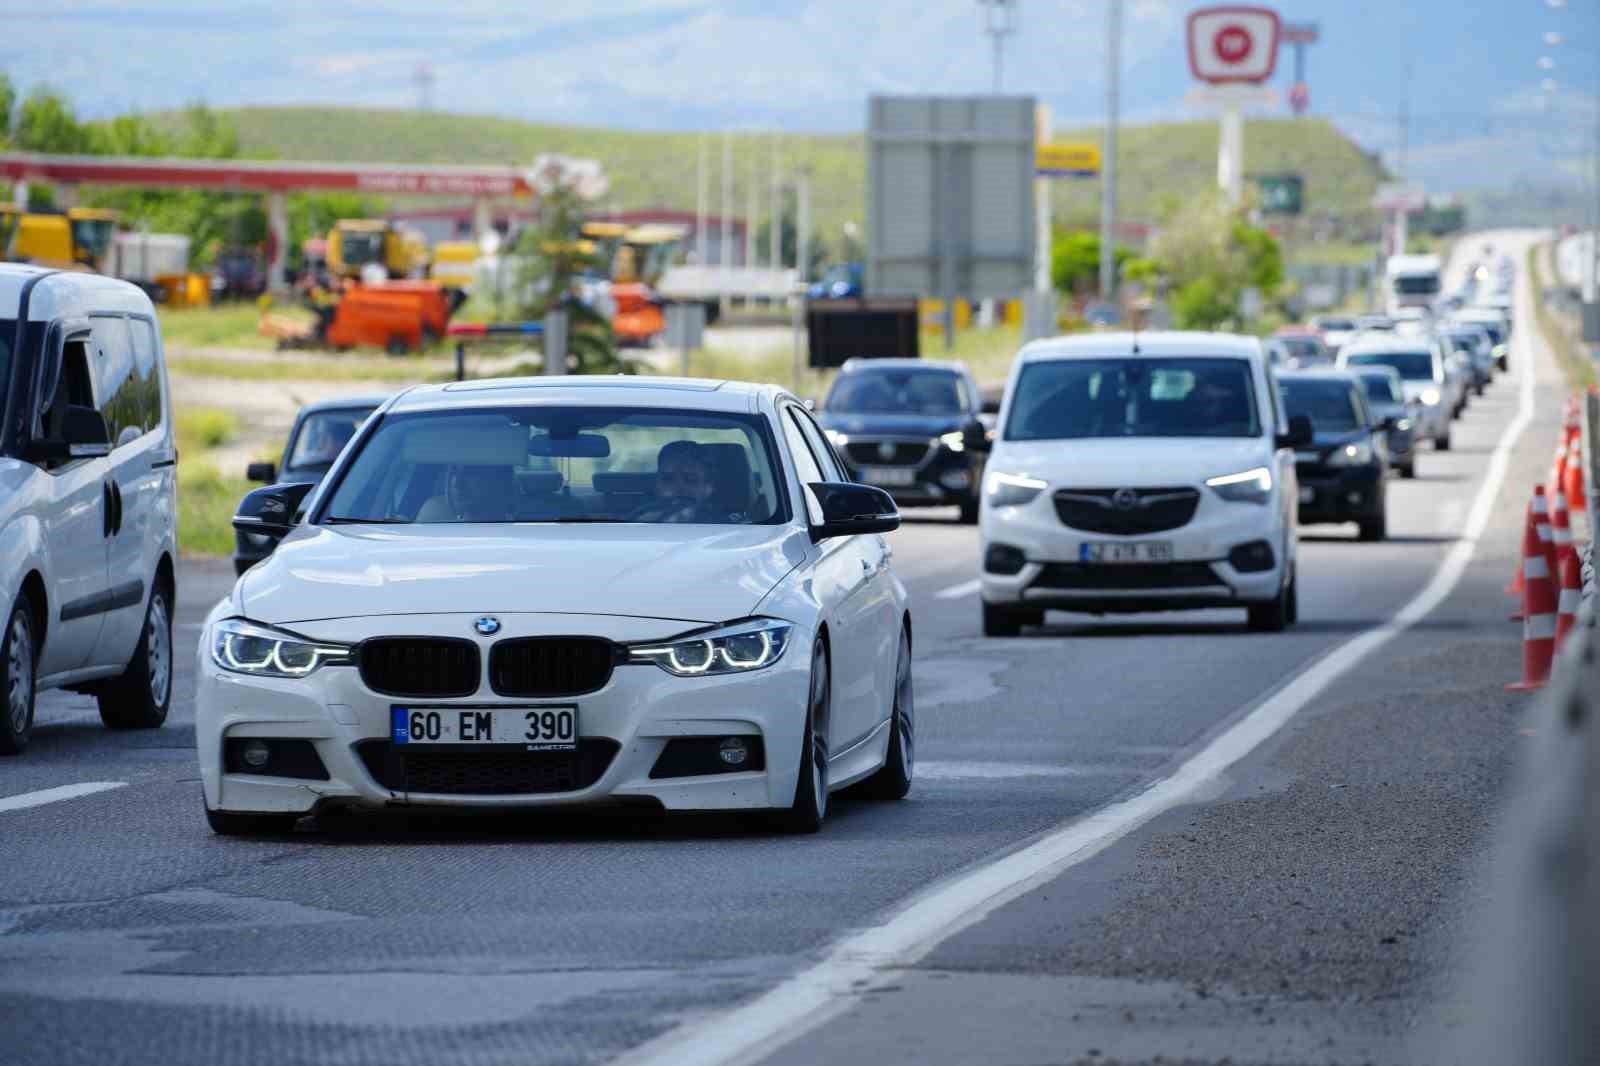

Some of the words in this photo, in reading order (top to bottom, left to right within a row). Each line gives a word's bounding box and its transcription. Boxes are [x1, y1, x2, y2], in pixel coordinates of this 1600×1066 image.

[410, 711, 441, 741] 60
[459, 711, 492, 741] EM
[525, 711, 573, 740] 390
